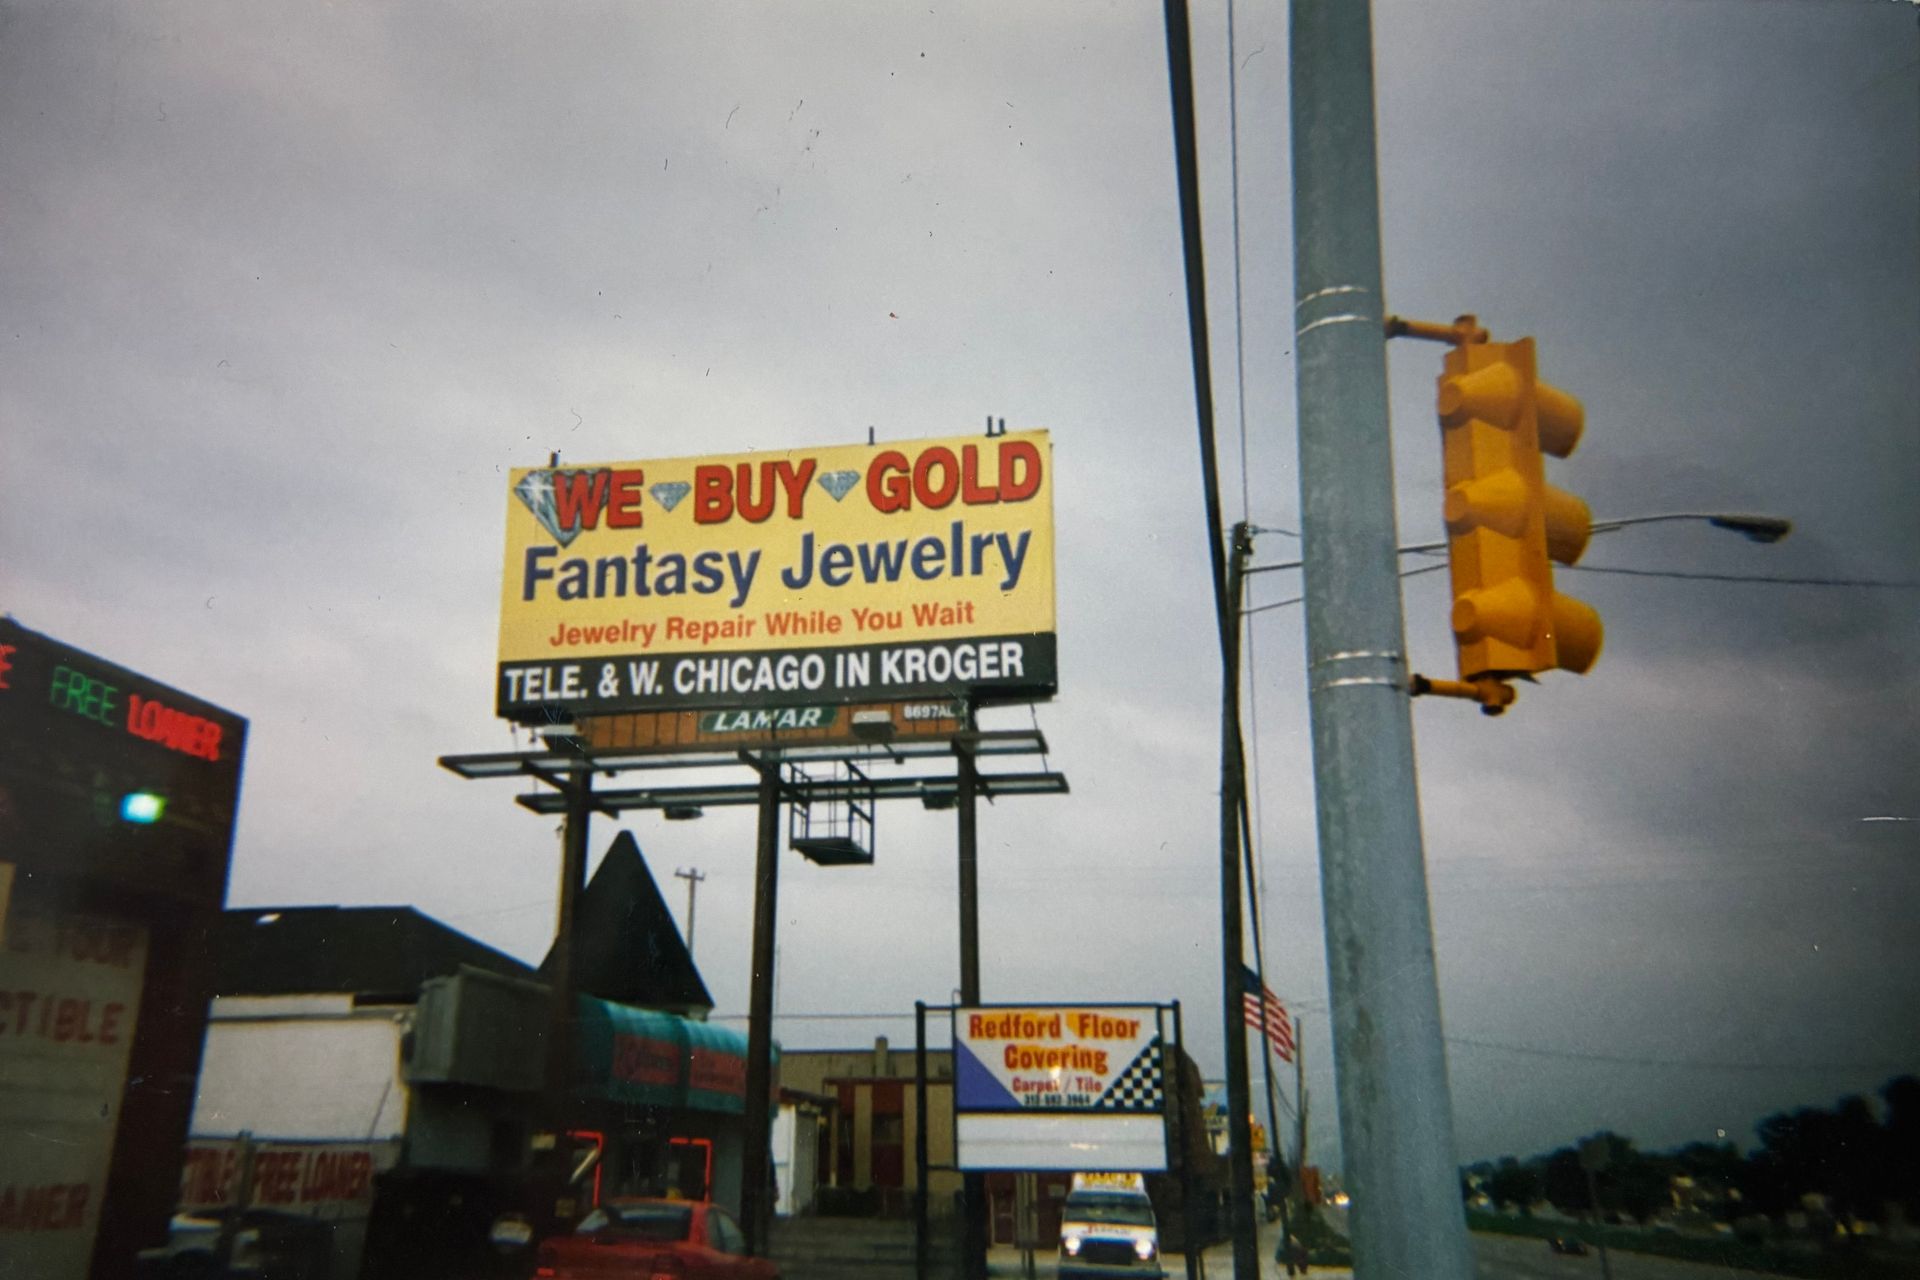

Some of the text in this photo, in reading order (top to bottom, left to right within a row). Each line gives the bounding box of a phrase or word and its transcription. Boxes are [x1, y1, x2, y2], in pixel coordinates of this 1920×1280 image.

[553, 440, 1043, 532] WE BUY GOLD
[523, 520, 1032, 608] Fantasy Jewelry
[549, 600, 976, 649] Jewelry Repair While You Wait
[49, 664, 119, 728] FREE
[504, 641, 1025, 702] TELE. & W. CHICAGO IN KROGER
[712, 706, 822, 732] LAMAR
[968, 1012, 1140, 1040] Redford Floor
[1004, 1045, 1108, 1076] Covering
[1075, 1076, 1103, 1093] Tile
